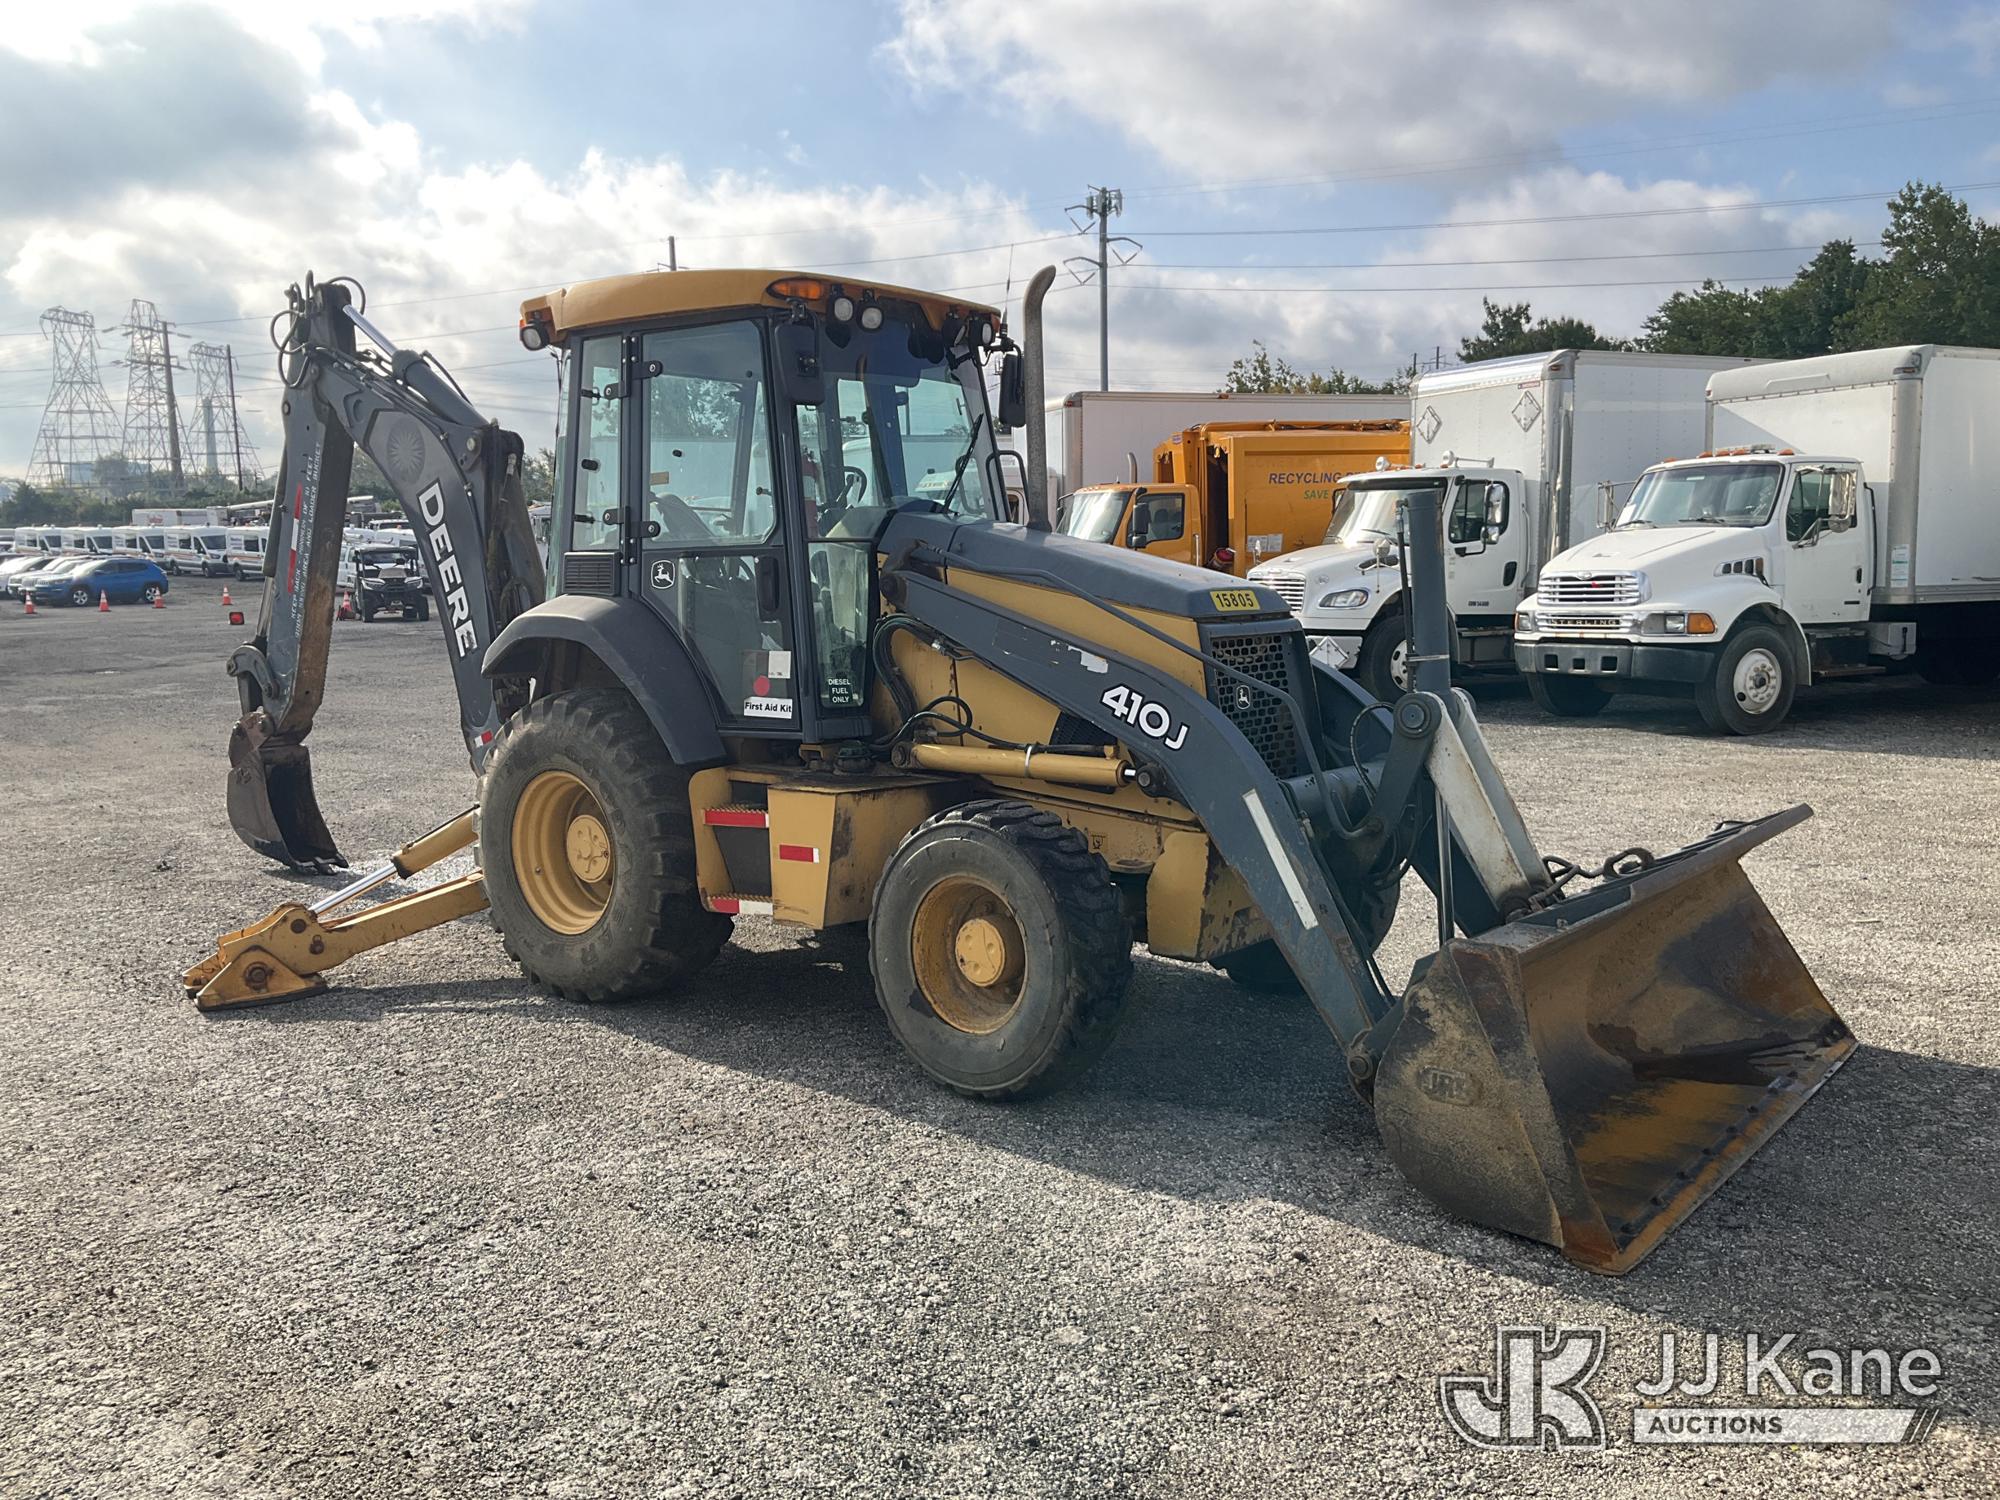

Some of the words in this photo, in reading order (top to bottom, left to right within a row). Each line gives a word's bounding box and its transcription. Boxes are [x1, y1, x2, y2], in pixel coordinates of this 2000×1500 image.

[306, 455, 314, 481] FEET
[312, 443, 321, 481] BUCKET
[1268, 472, 1341, 484] RECYCLING
[308, 486, 317, 523] LOADER
[1304, 489, 1329, 500] SAVE
[302, 553, 310, 577] AREA
[417, 485, 479, 659] DEERE
[1215, 591, 1255, 609] 15805
[1551, 618, 1617, 626] STERLING
[828, 678, 851, 686] DIESEL
[744, 702, 763, 711] First
[764, 703, 778, 712] Aid
[780, 704, 792, 713] Kit
[1101, 684, 1190, 752] 410J
